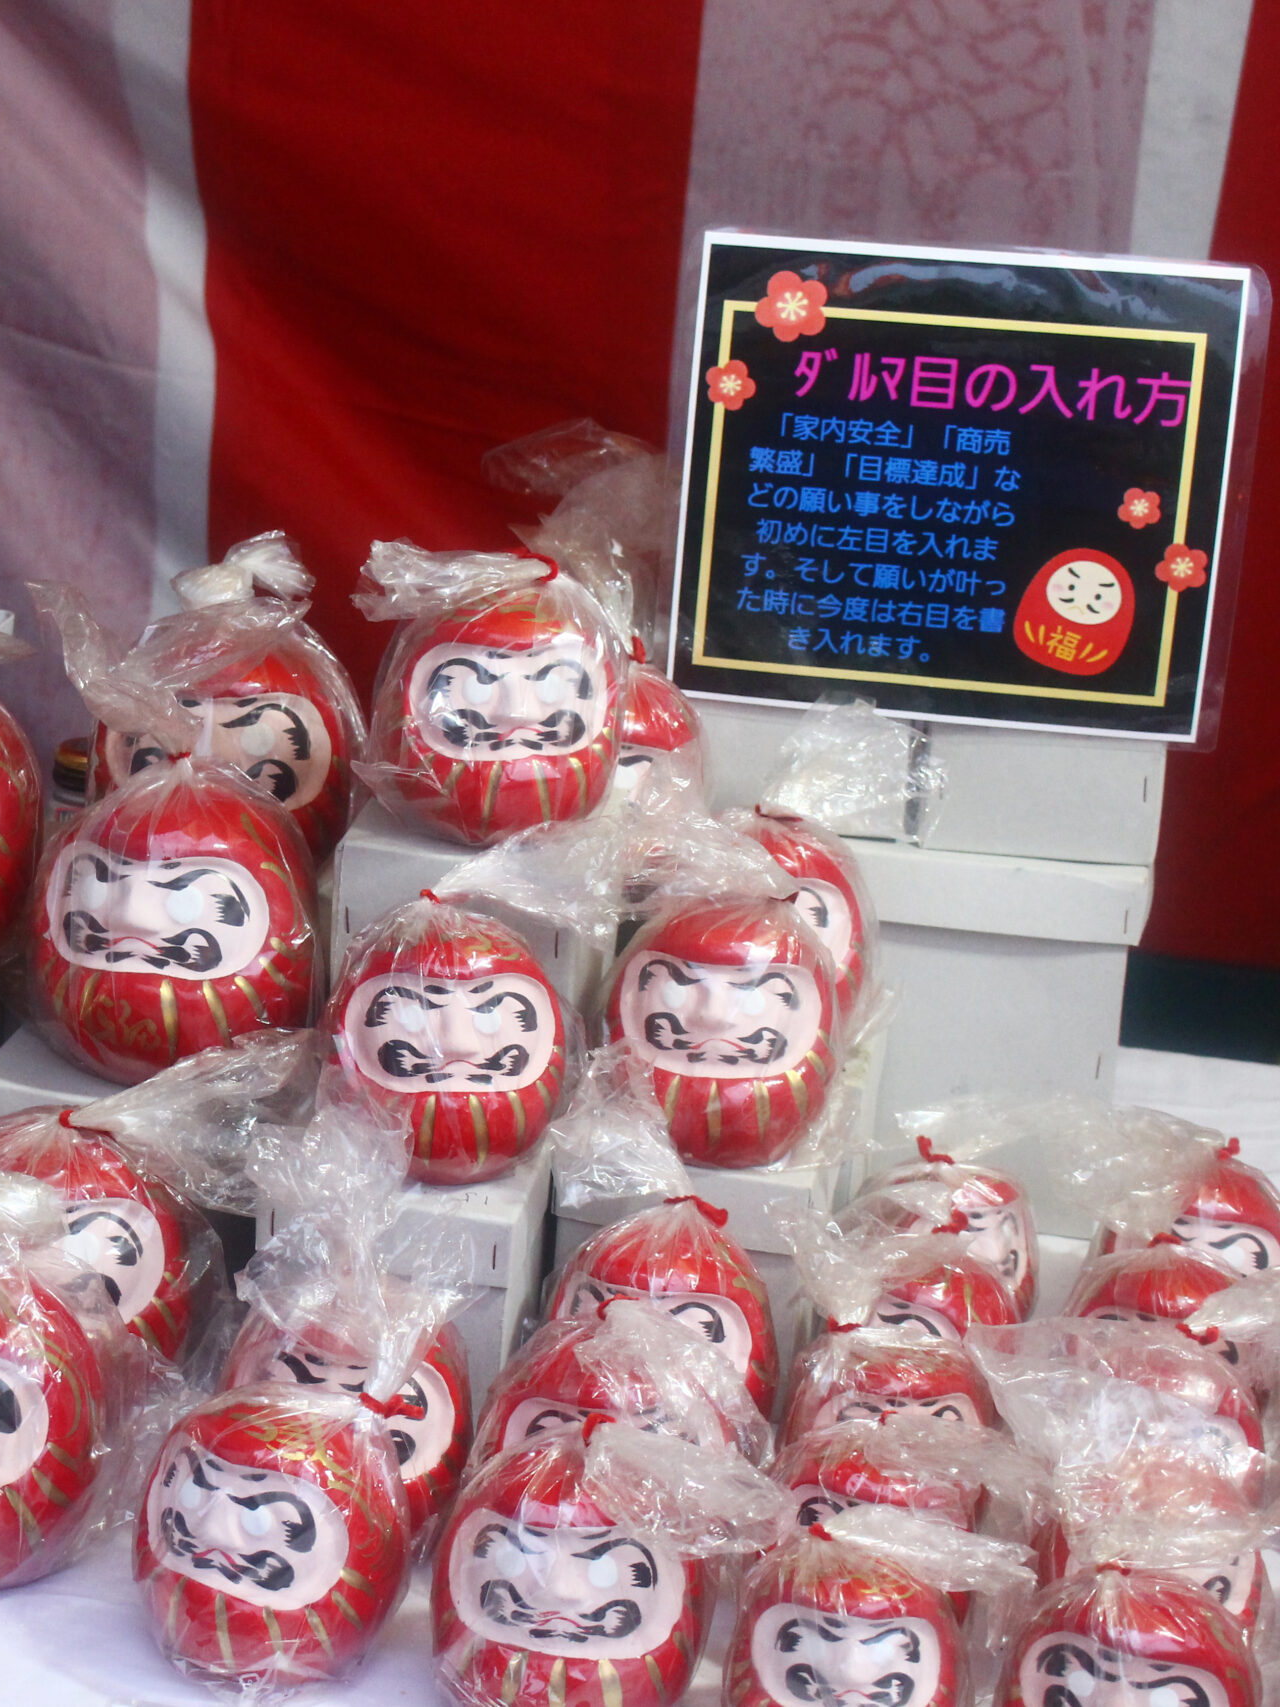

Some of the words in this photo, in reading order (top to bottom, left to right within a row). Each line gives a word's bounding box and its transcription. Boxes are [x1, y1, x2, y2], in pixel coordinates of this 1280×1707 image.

[747, 481, 1016, 527] どの願い事をしながら
[756, 518, 999, 561] 初めに左目を入れま
[740, 552, 1007, 597] す。そして願いが叶っ
[736, 585, 1006, 633] た時に今度は右目を書
[787, 626, 930, 663] き入れます。
[1046, 625, 1082, 662] 福
